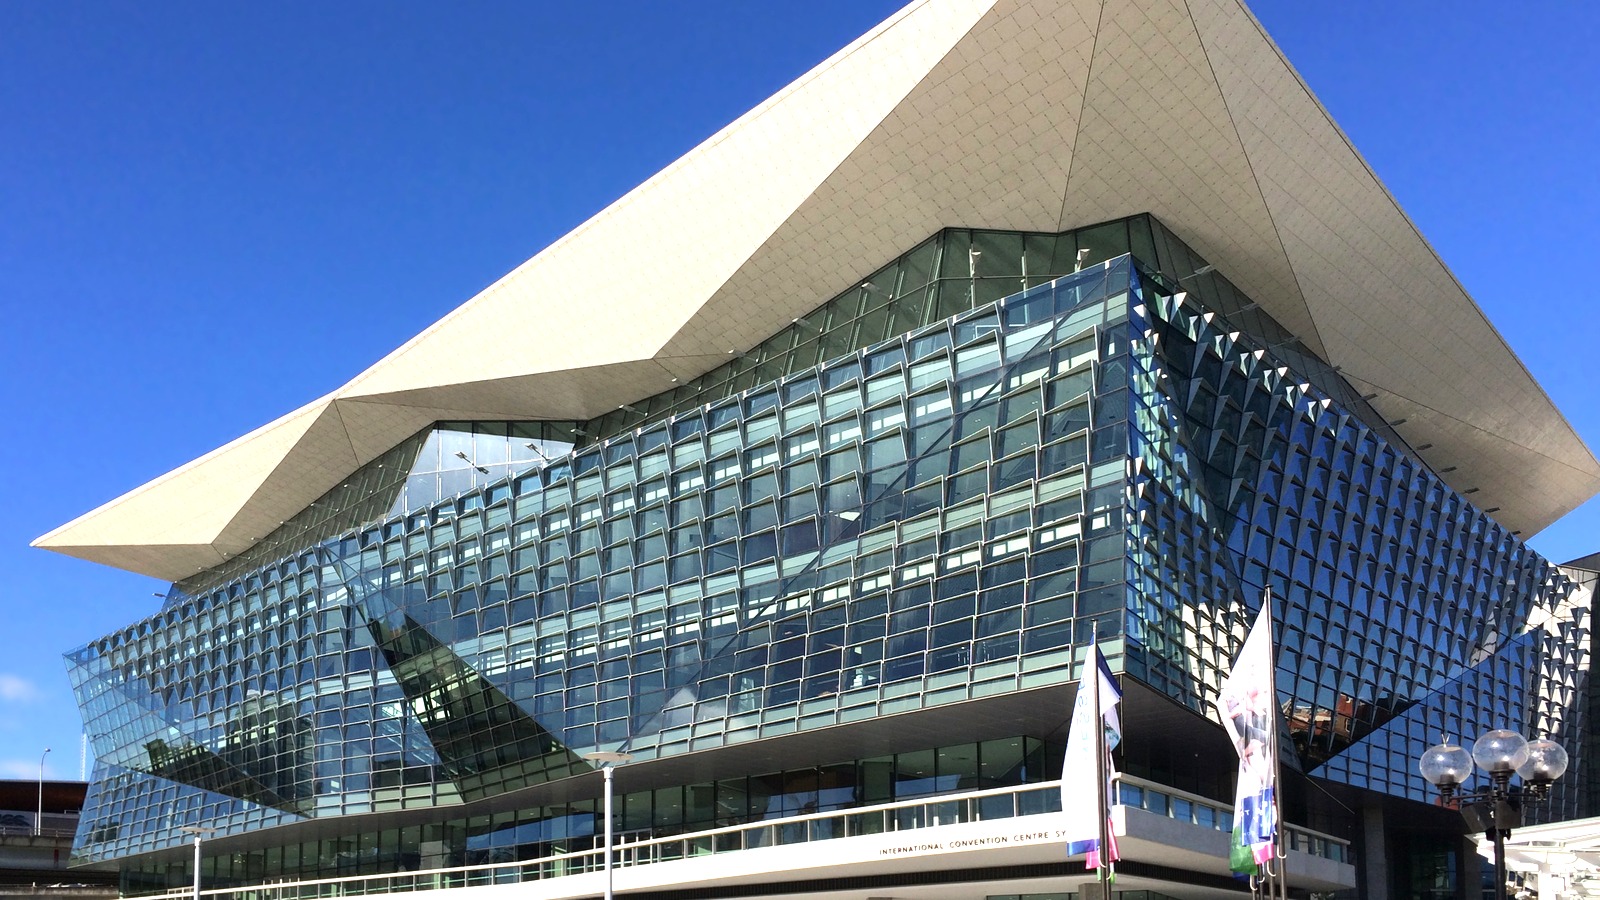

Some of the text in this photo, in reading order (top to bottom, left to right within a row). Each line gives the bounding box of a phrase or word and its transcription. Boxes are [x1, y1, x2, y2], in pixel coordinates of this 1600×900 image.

[880, 843, 943, 855] INTERNATIONAL
[949, 836, 1008, 849] CONVENTION
[1013, 831, 1049, 842] CENTRE
